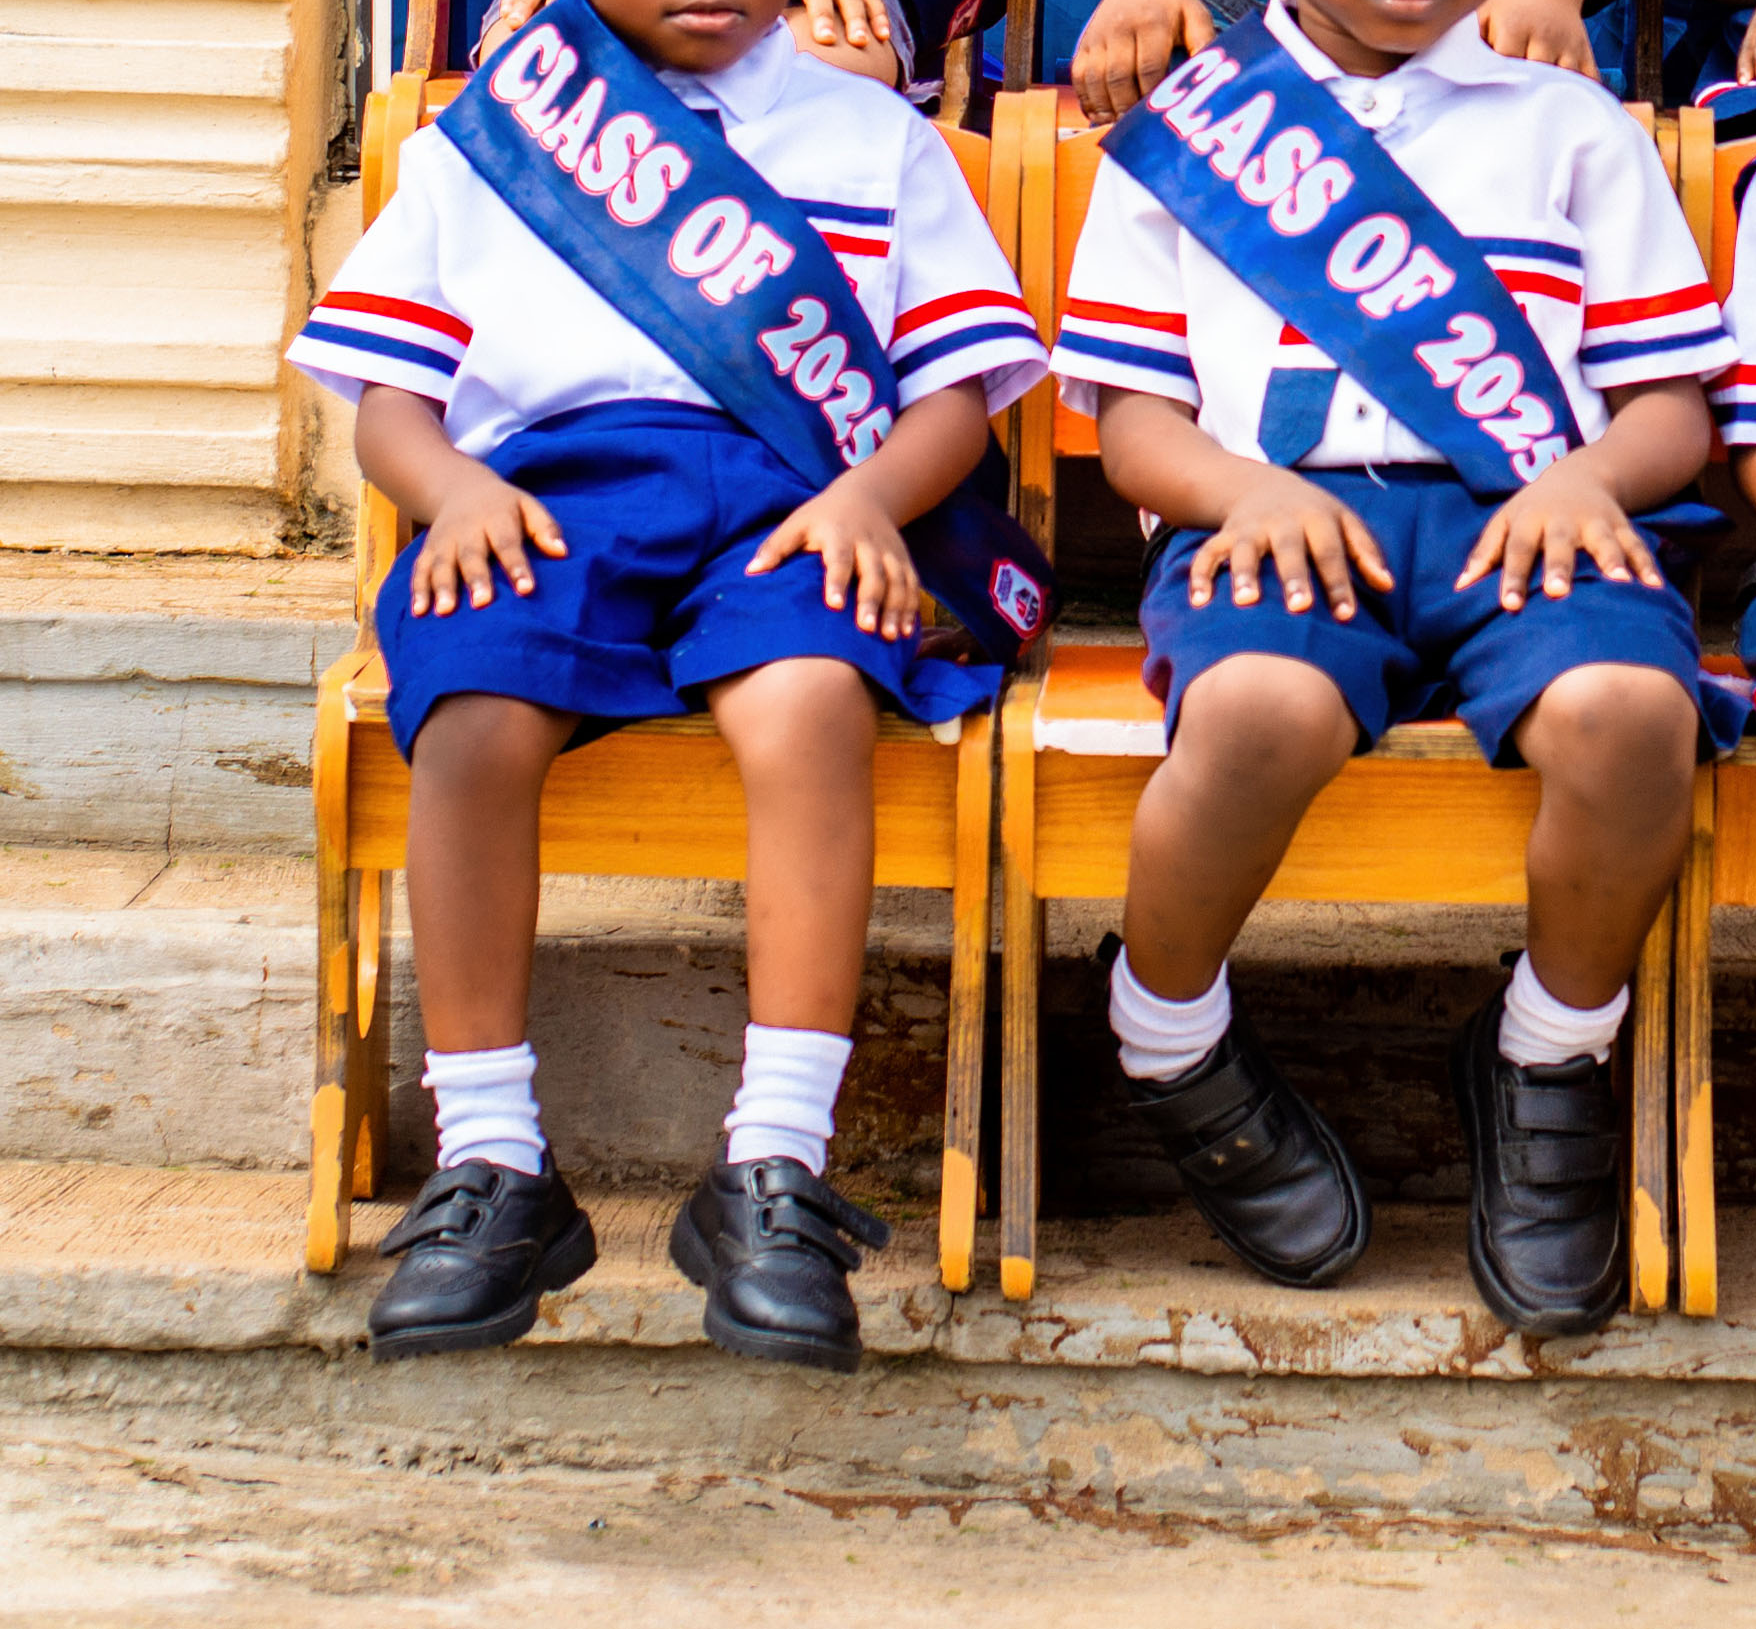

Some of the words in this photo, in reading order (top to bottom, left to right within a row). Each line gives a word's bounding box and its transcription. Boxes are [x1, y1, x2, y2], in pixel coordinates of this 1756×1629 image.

[490, 23, 691, 227] CLASS
[668, 195, 794, 304] OF
[757, 295, 894, 467] 2025
[1148, 47, 1354, 236] CLASS
[1326, 212, 1456, 319] OF
[1413, 312, 1570, 484] 2025
